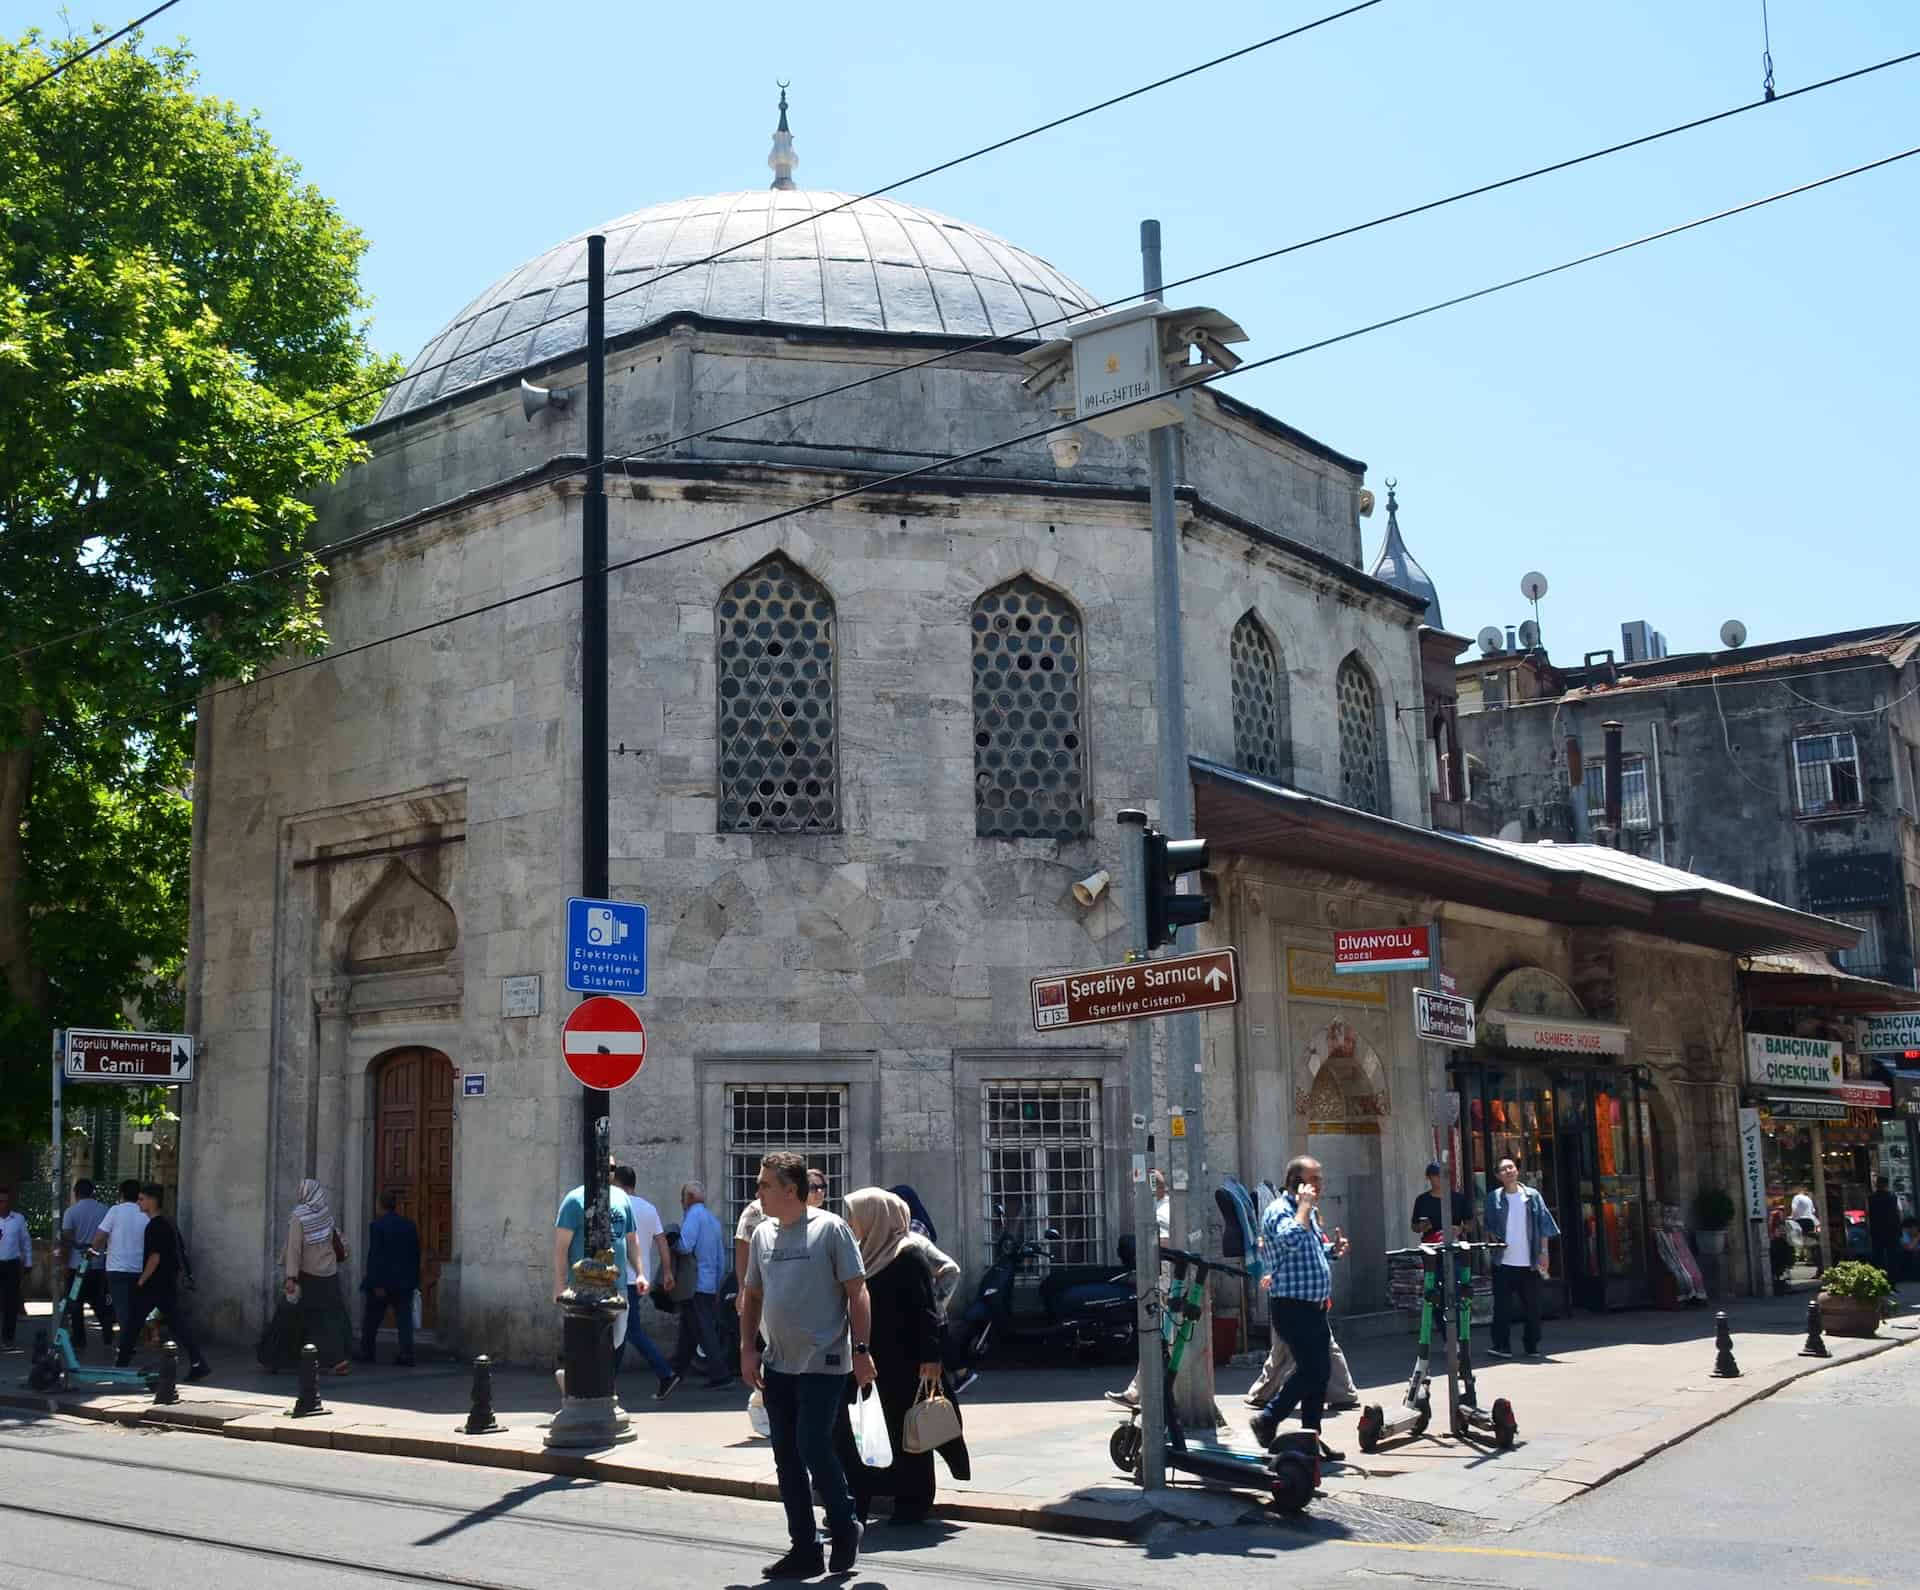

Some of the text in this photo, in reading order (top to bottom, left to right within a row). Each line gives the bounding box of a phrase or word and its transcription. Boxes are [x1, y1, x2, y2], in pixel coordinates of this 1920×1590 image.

[1339, 933, 1412, 950] DİVANYOLU
[575, 948, 639, 962] Elektronik
[573, 961, 640, 976] Denetleme
[583, 975, 631, 987] Sistemi
[1071, 966, 1201, 1002] Şerefiye Sarnıcı
[1088, 993, 1186, 1017] (Şerefiye Cistern)
[72, 1038, 171, 1053] Köprülü Mehmet Paşa
[1535, 1031, 1576, 1048] CASHMERE
[1766, 1037, 1829, 1059] BAHÇIVAN
[99, 1056, 144, 1073] Camii
[1766, 1060, 1830, 1084] ÇİÇEKÇİLİK
